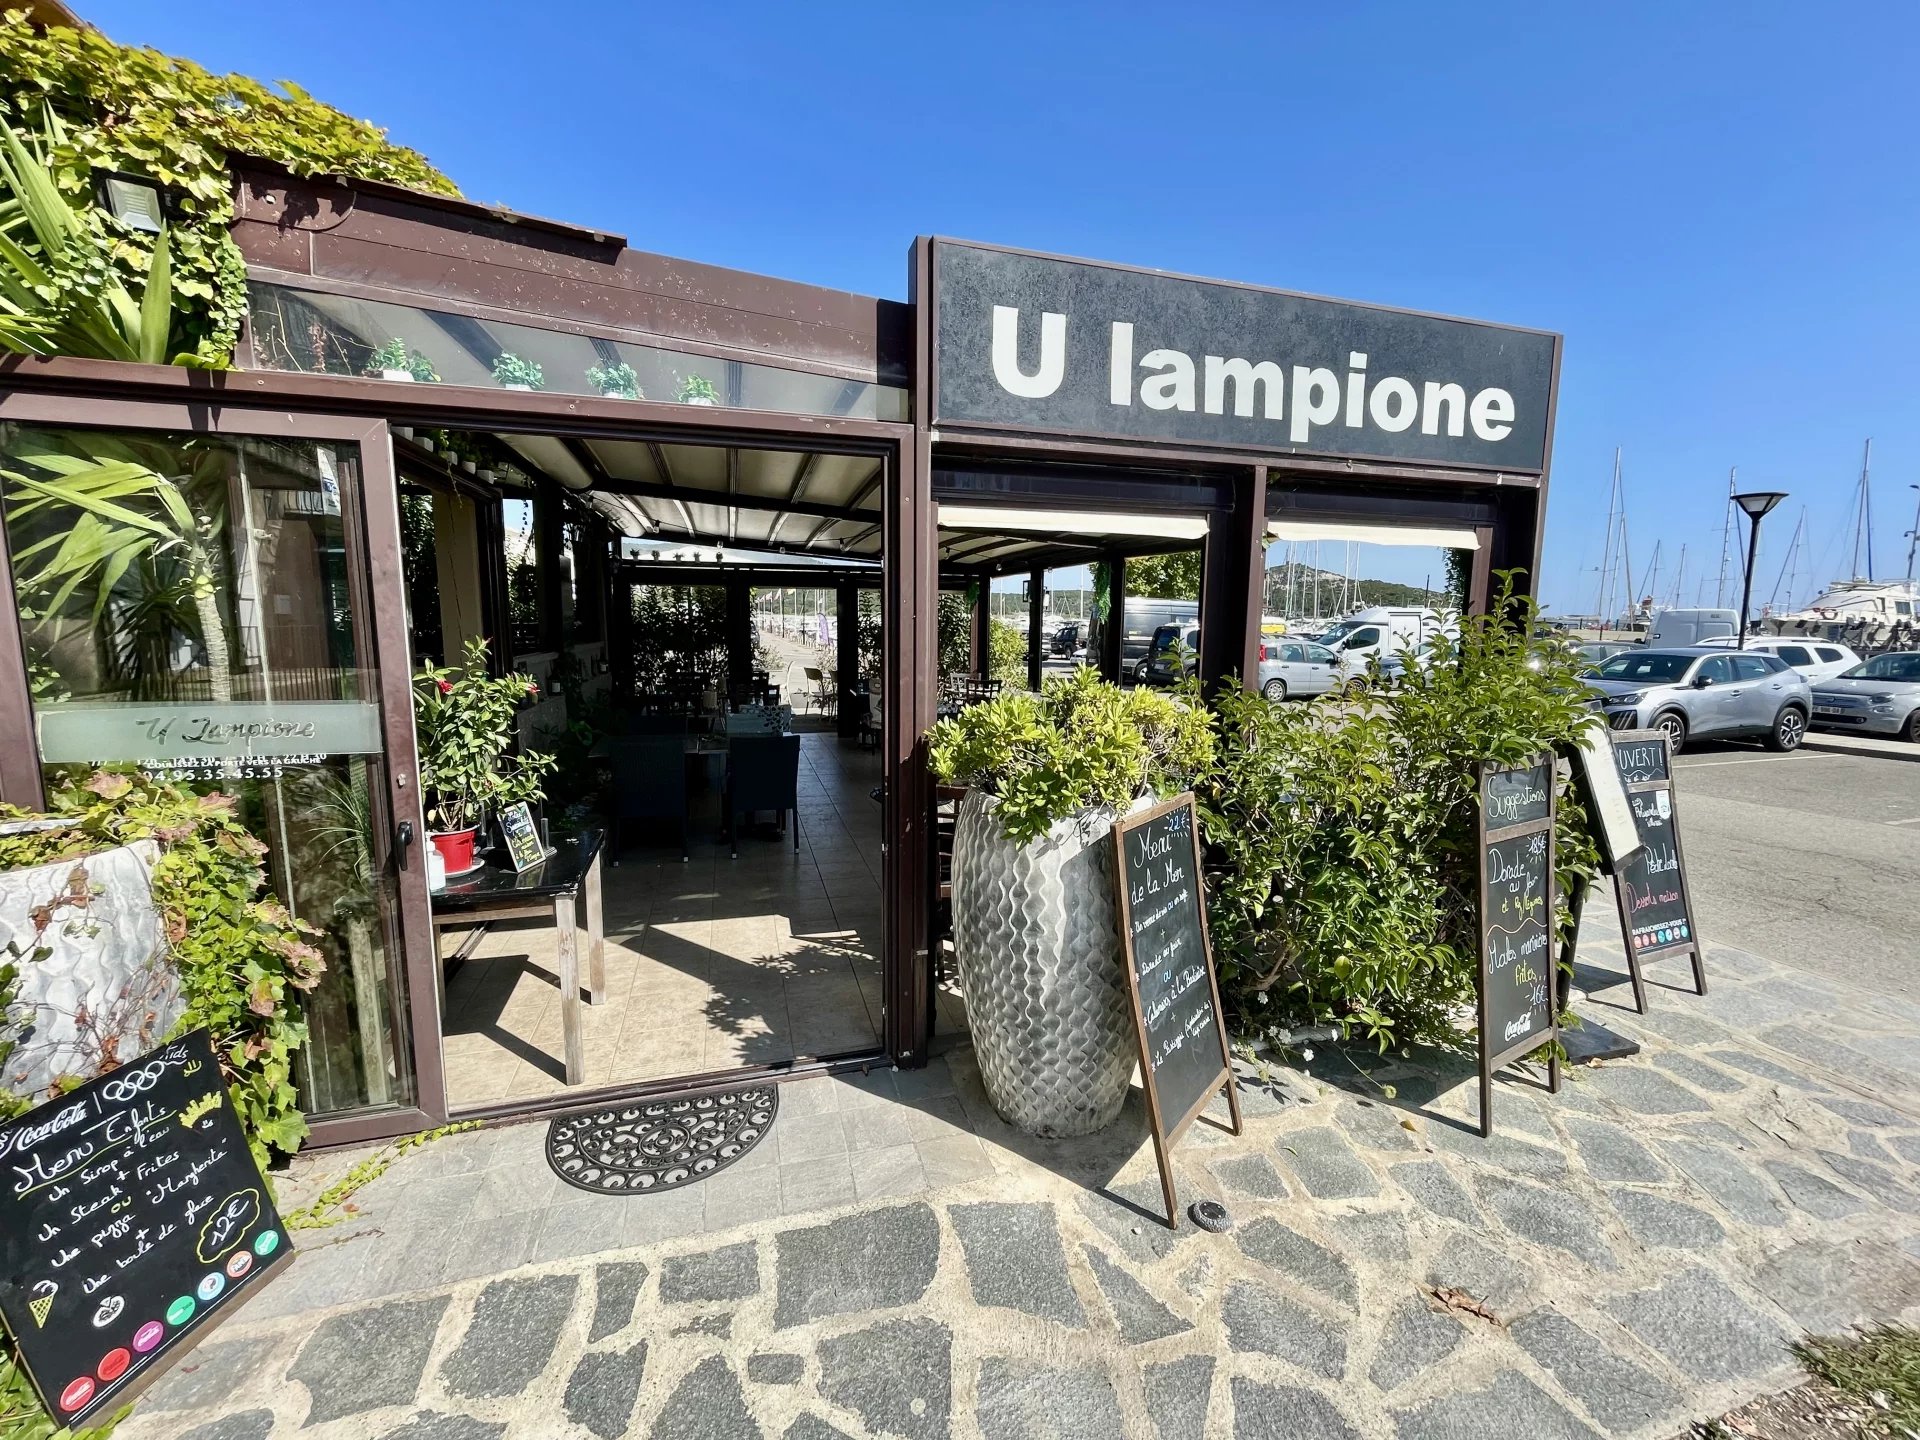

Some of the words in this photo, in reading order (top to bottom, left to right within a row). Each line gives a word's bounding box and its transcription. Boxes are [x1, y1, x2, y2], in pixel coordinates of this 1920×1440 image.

[993, 305, 1067, 398] U
[1111, 321, 1515, 442] lampione
[1619, 748, 1656, 770] UVERT
[1488, 776, 1546, 820] Suggestions
[1169, 813, 1186, 831] 22€
[1134, 827, 1172, 868] Menu
[1489, 848, 1526, 884] Dorade
[1131, 881, 1144, 906] de
[1147, 868, 1160, 894] la
[1163, 859, 1184, 887] Mer
[1510, 881, 1520, 893] au
[13, 1142, 94, 1193] Menu
[106, 1101, 168, 1143] Enfants
[71, 1186, 123, 1224] Steak
[137, 1152, 180, 1180] Frites
[81, 1160, 119, 1185] Sirop
[111, 1196, 132, 1214] ou
[51, 1248, 81, 1267] Une
[91, 1213, 136, 1248] pizza
[84, 1274, 112, 1294] Une
[116, 1241, 155, 1268] boule
[159, 1223, 178, 1241] de
[184, 1195, 215, 1225] glace
